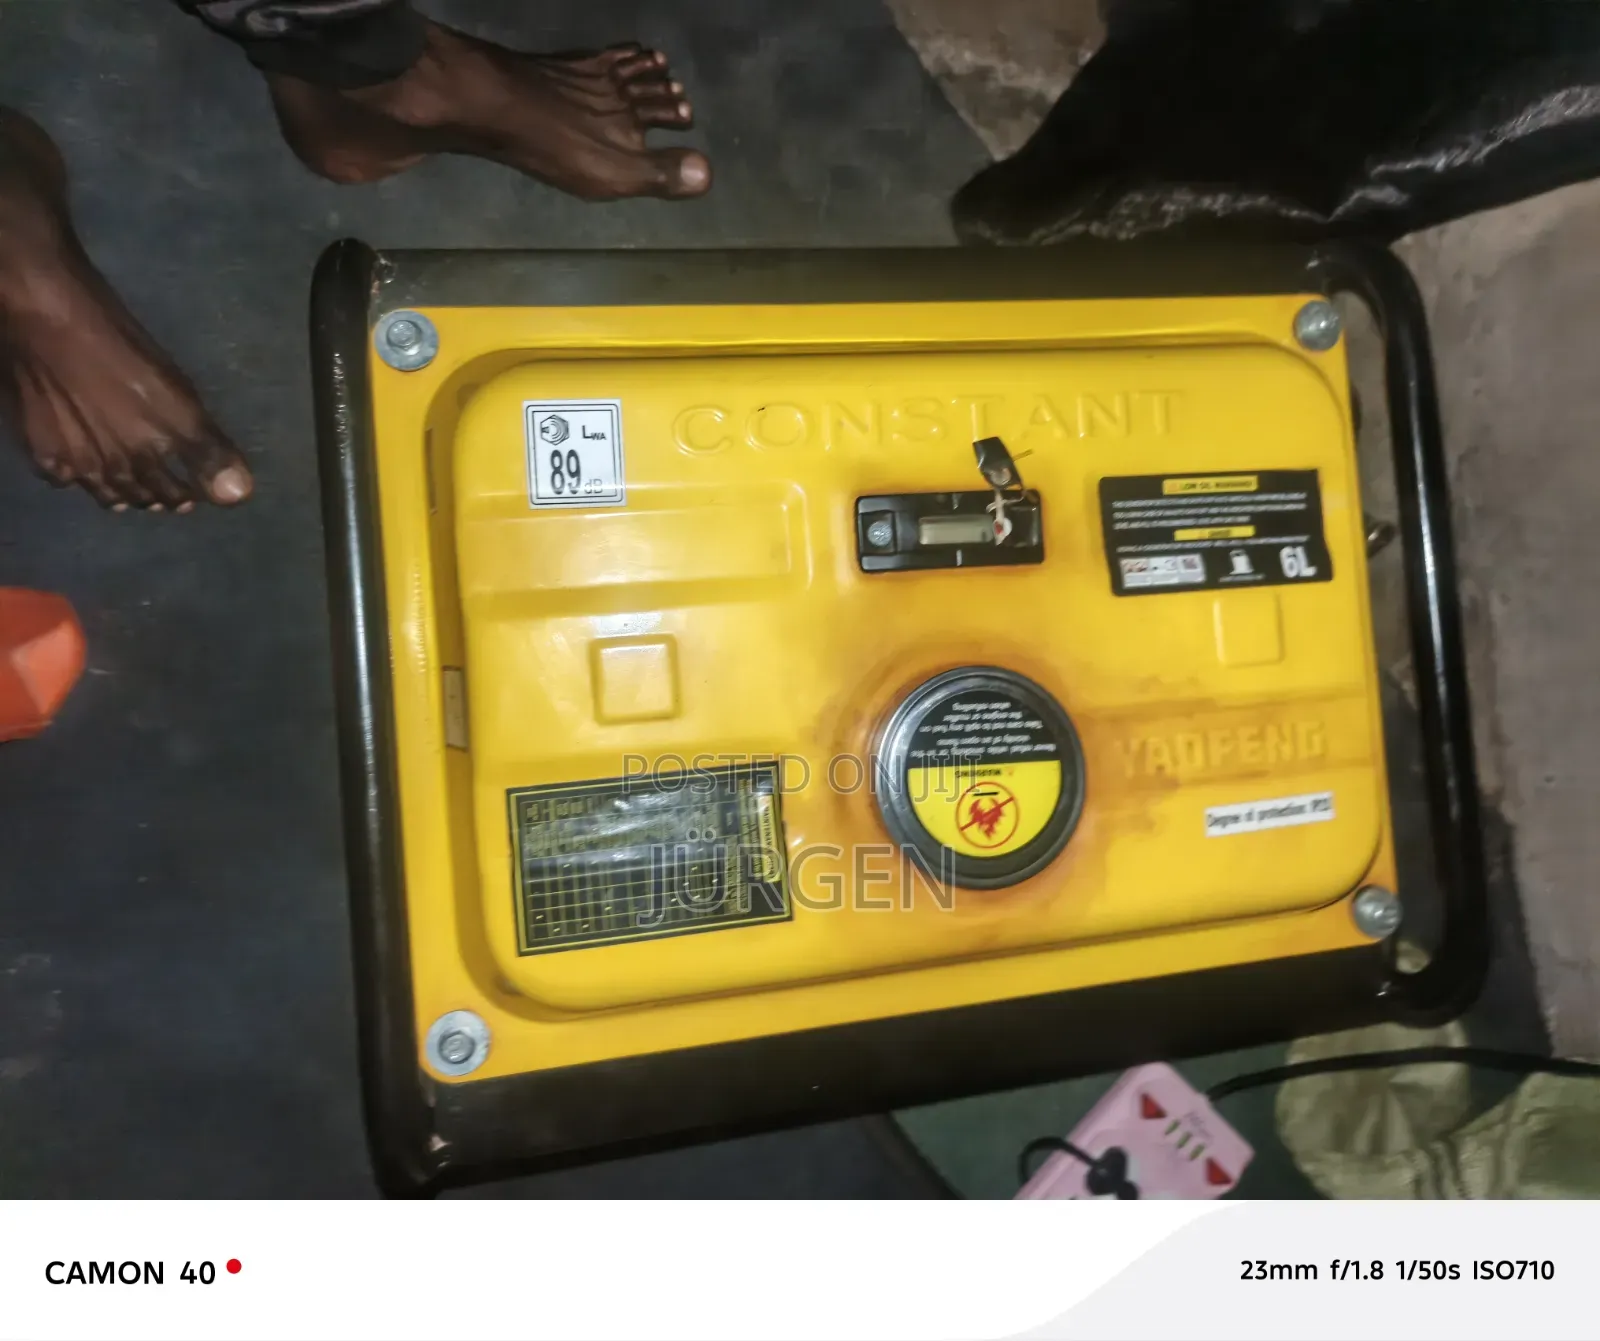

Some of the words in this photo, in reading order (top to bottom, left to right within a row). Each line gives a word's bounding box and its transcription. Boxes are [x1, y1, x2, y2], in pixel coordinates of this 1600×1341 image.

[672, 389, 1186, 456] CONSTANT
[550, 449, 582, 495] 89
[584, 478, 604, 495] dB
[1279, 545, 1318, 579] 6L
